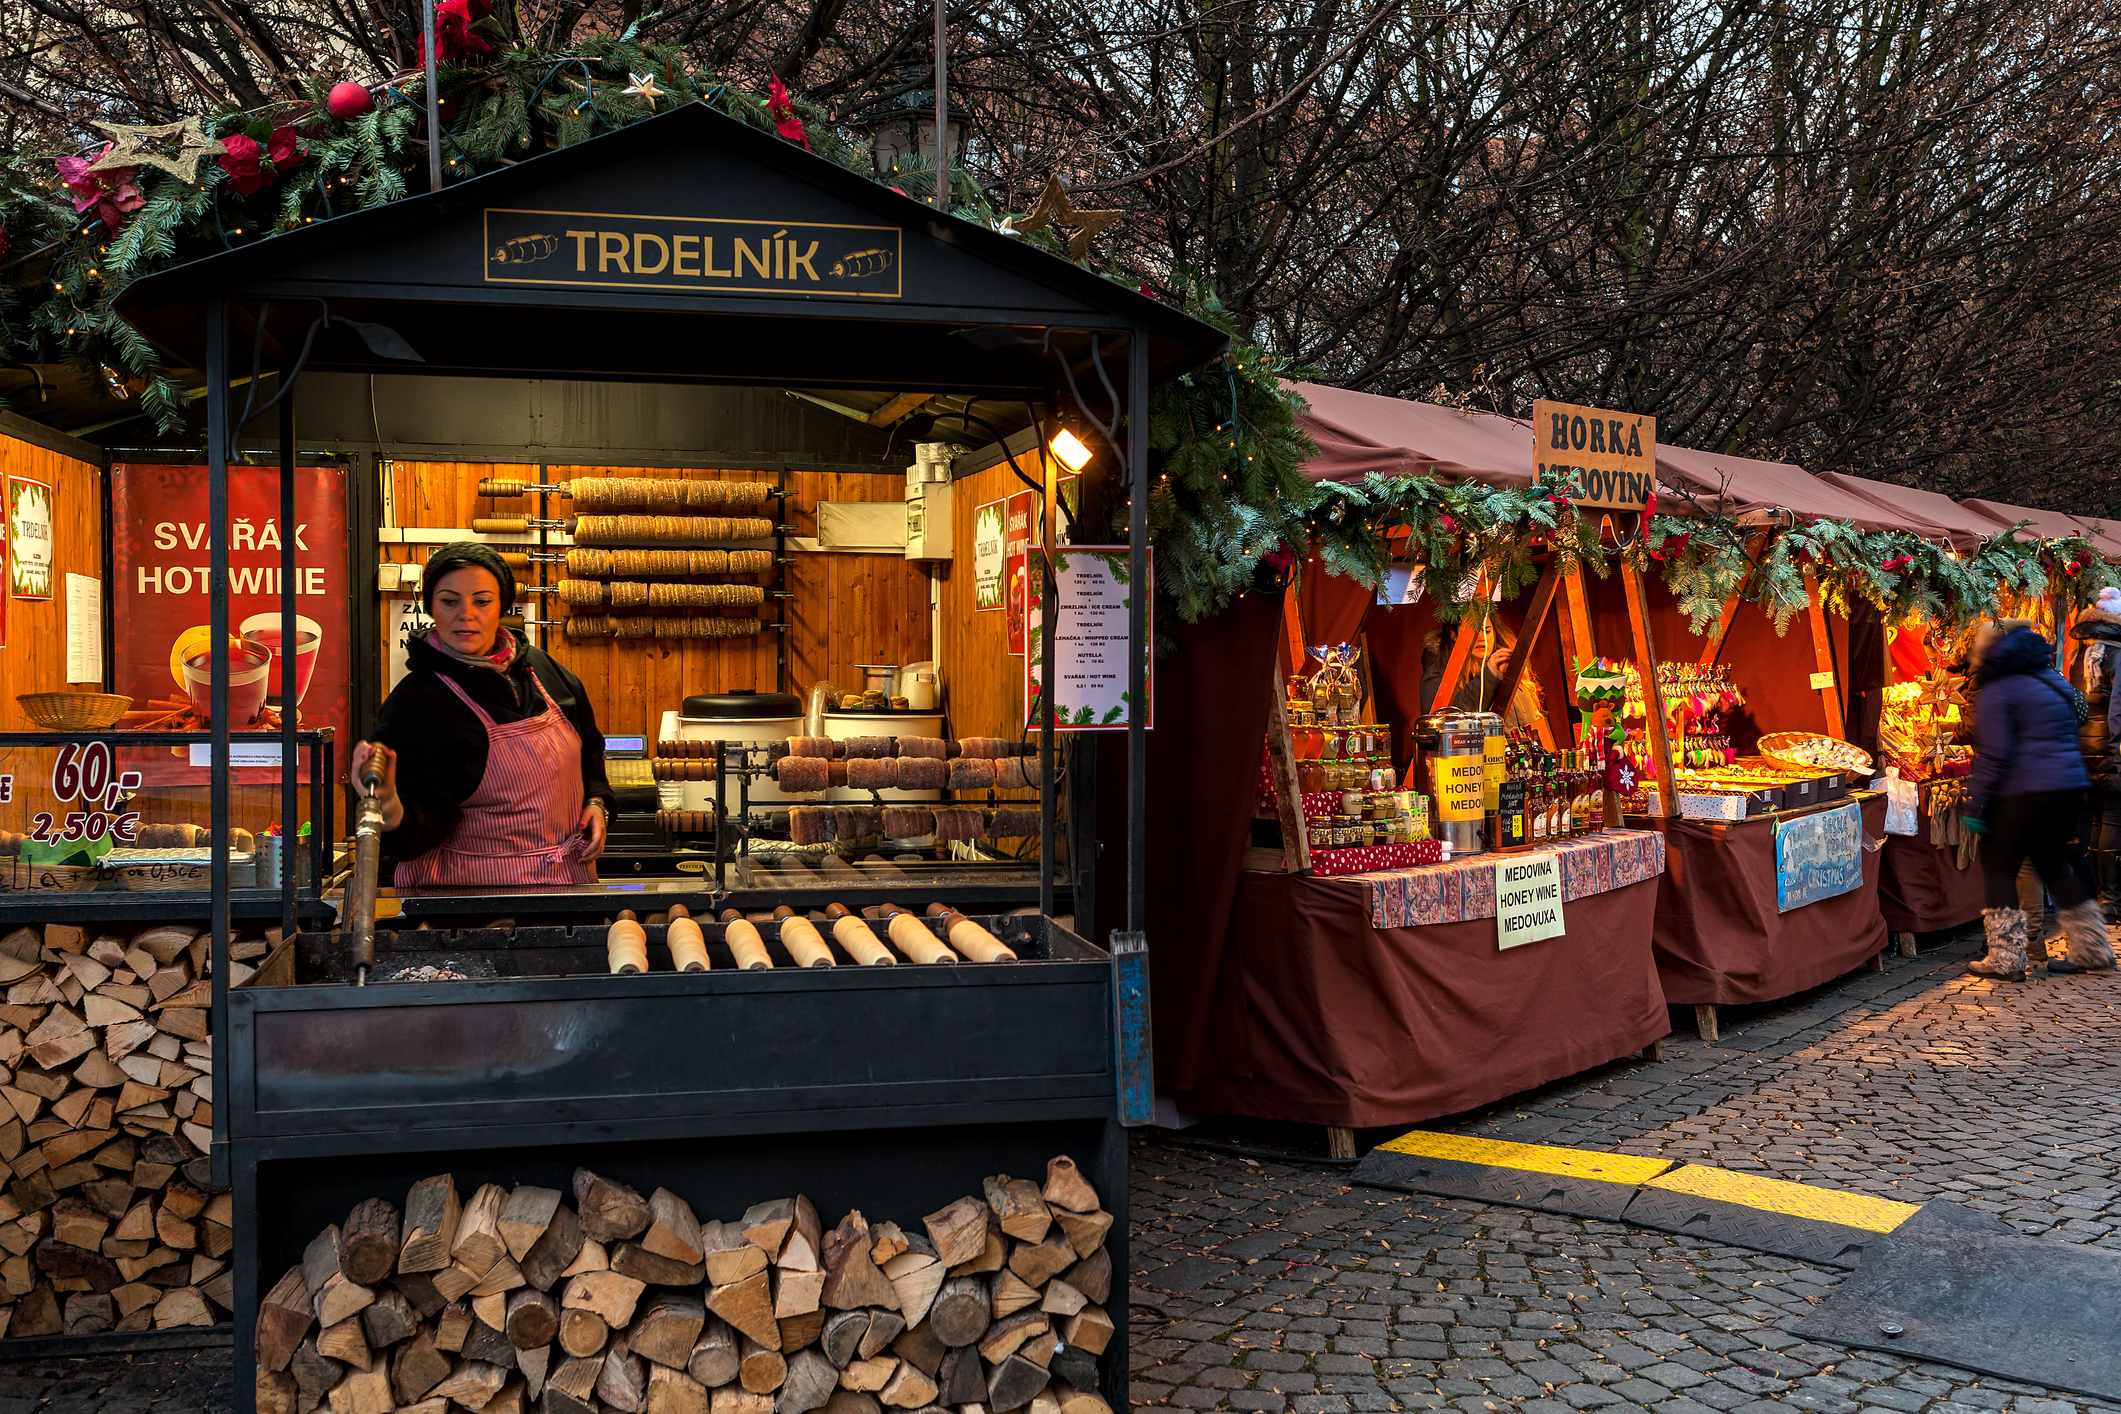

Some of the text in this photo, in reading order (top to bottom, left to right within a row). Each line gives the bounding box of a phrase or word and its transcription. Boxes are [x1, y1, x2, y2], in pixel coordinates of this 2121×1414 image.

[566, 229, 820, 281] TRDELNÍK
[1551, 413, 1643, 458] HORKÁ
[154, 518, 309, 550] SVŘÁK
[138, 566, 211, 595] HOT
[53, 741, 142, 811] 60,-
[1446, 782, 1482, 794] HONEY
[1504, 860, 1553, 883] MEDOVINA
[1500, 883, 1558, 909] HONEY WINE
[1504, 908, 1557, 933] MEDOVUXA
